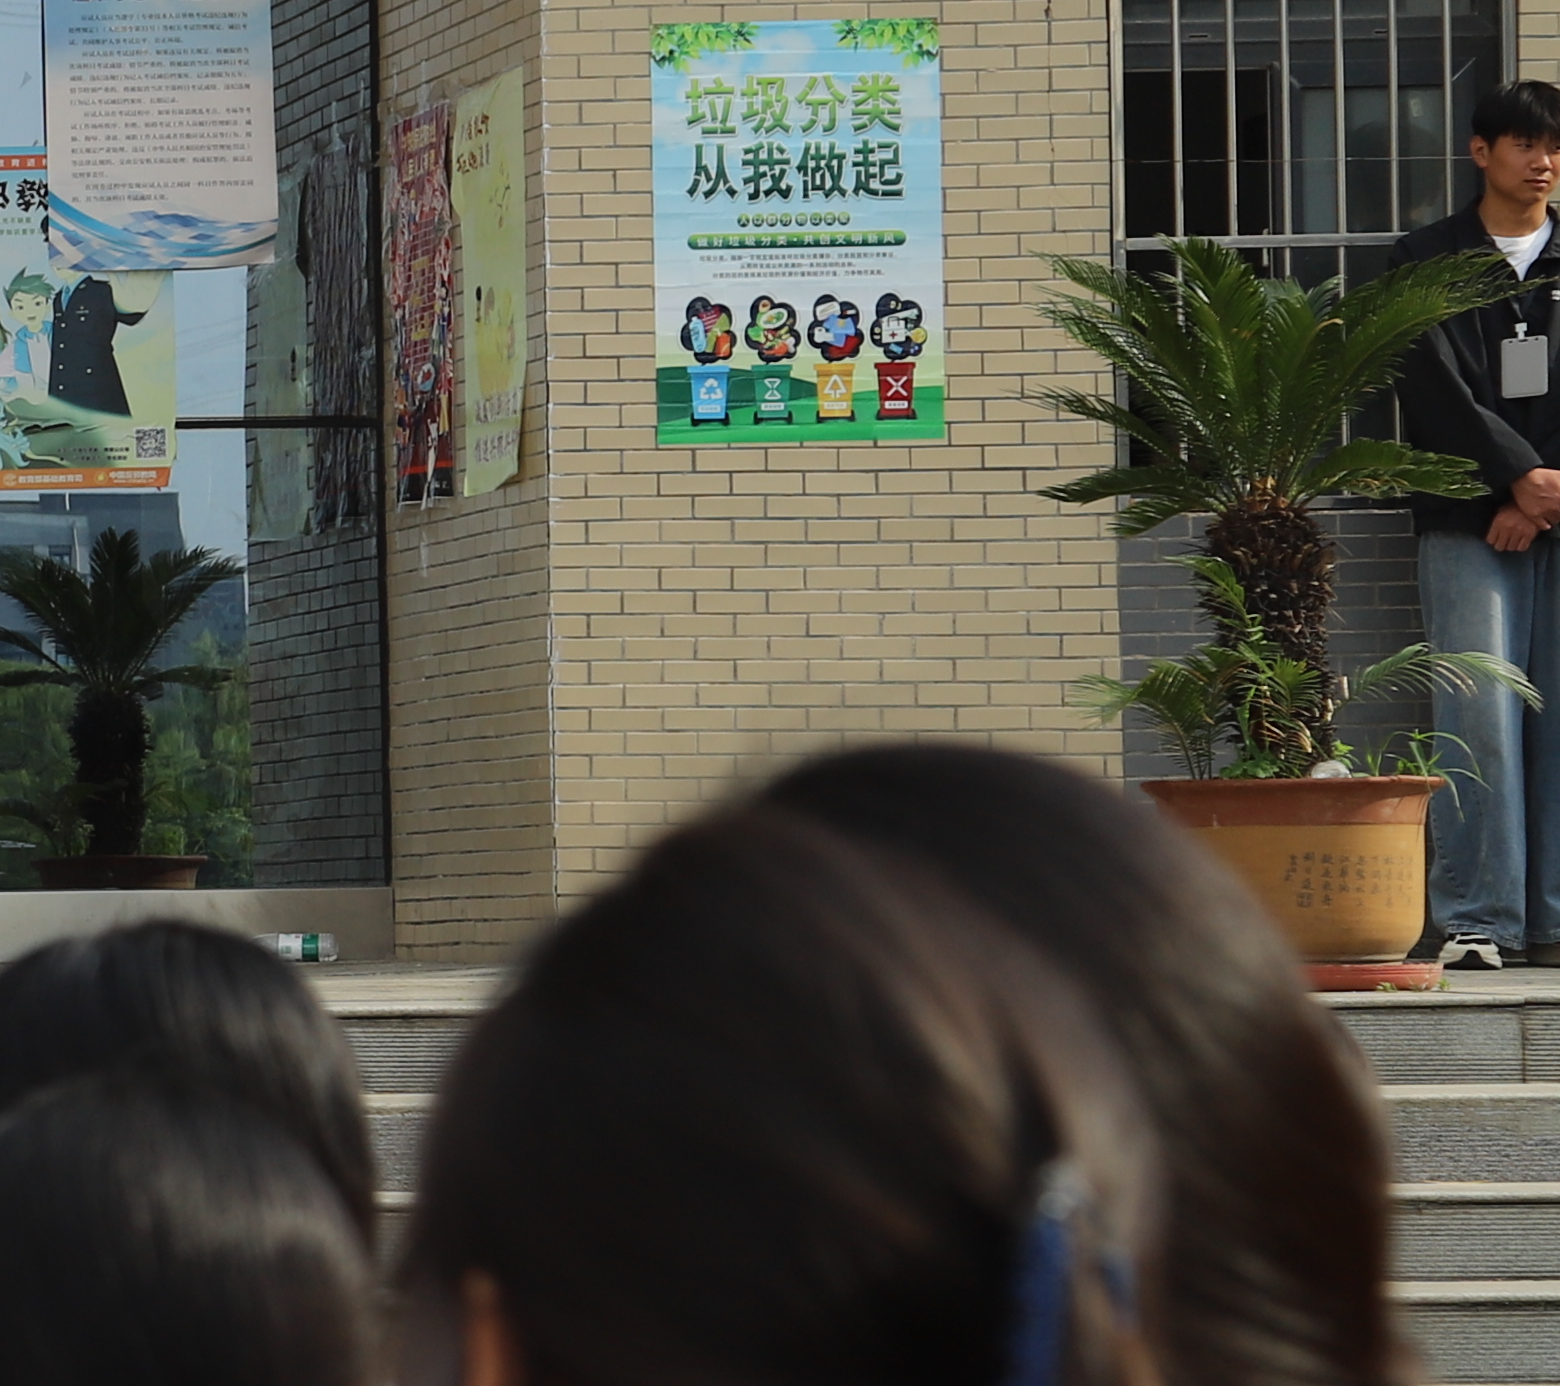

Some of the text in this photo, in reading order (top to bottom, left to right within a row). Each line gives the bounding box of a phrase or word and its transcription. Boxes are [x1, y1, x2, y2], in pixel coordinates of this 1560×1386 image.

[685, 72, 902, 136] 垃圾分类
[685, 140, 906, 202] 从我做起
